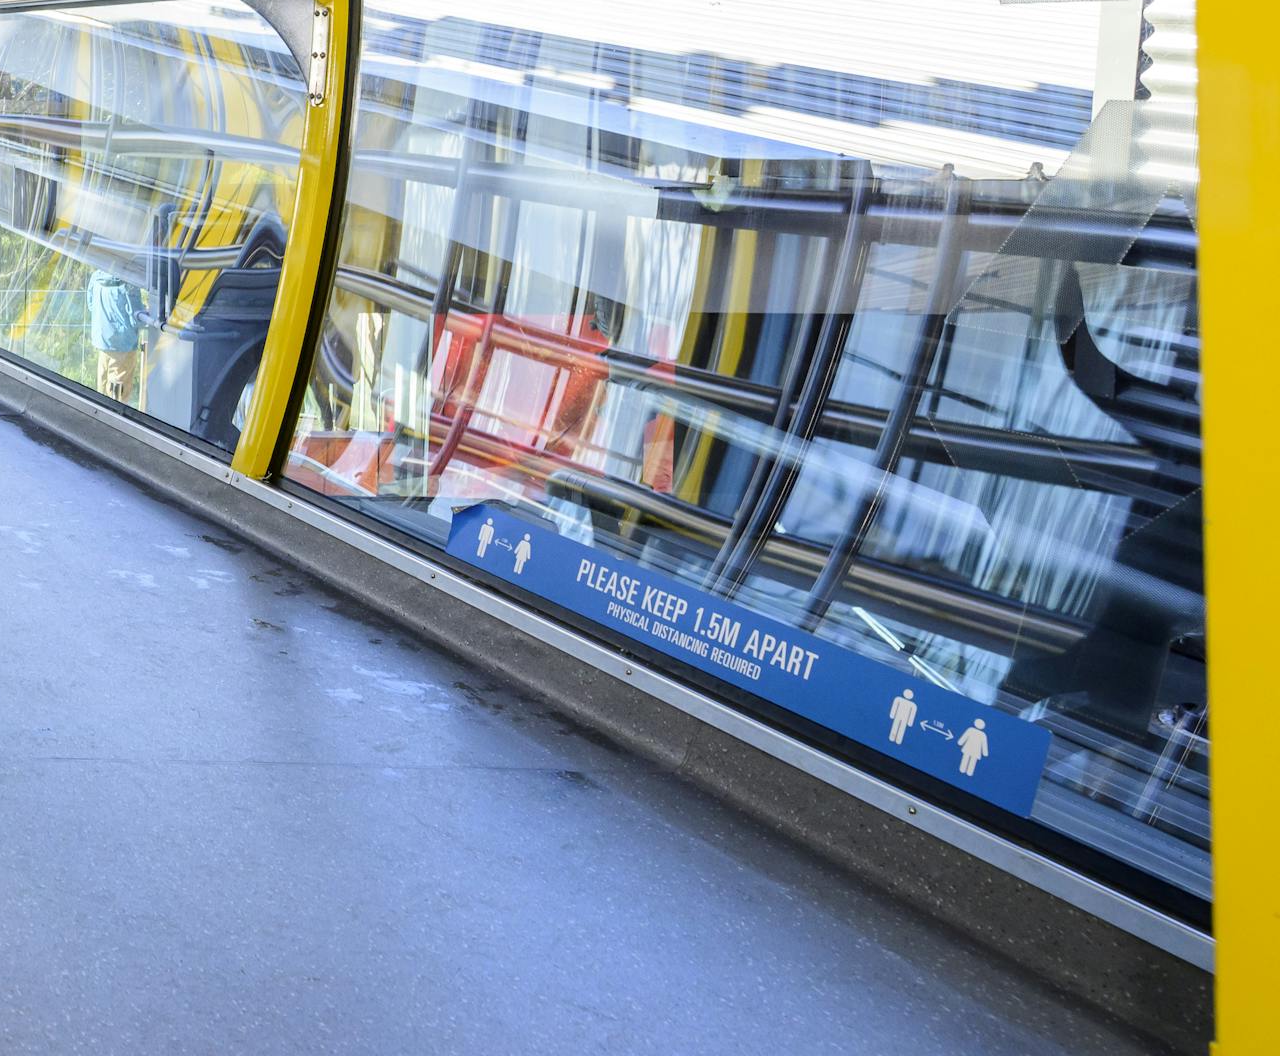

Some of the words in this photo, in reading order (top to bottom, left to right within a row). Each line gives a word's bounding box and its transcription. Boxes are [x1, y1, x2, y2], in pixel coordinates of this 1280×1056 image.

[576, 558, 641, 606] PLEASE
[641, 584, 688, 624] KEEP
[692, 607, 742, 649] 1.5M
[742, 629, 820, 682] APART
[606, 601, 650, 633] PHYSICAL
[651, 621, 709, 657] DISTANCING
[709, 645, 762, 681] REQUIRED
